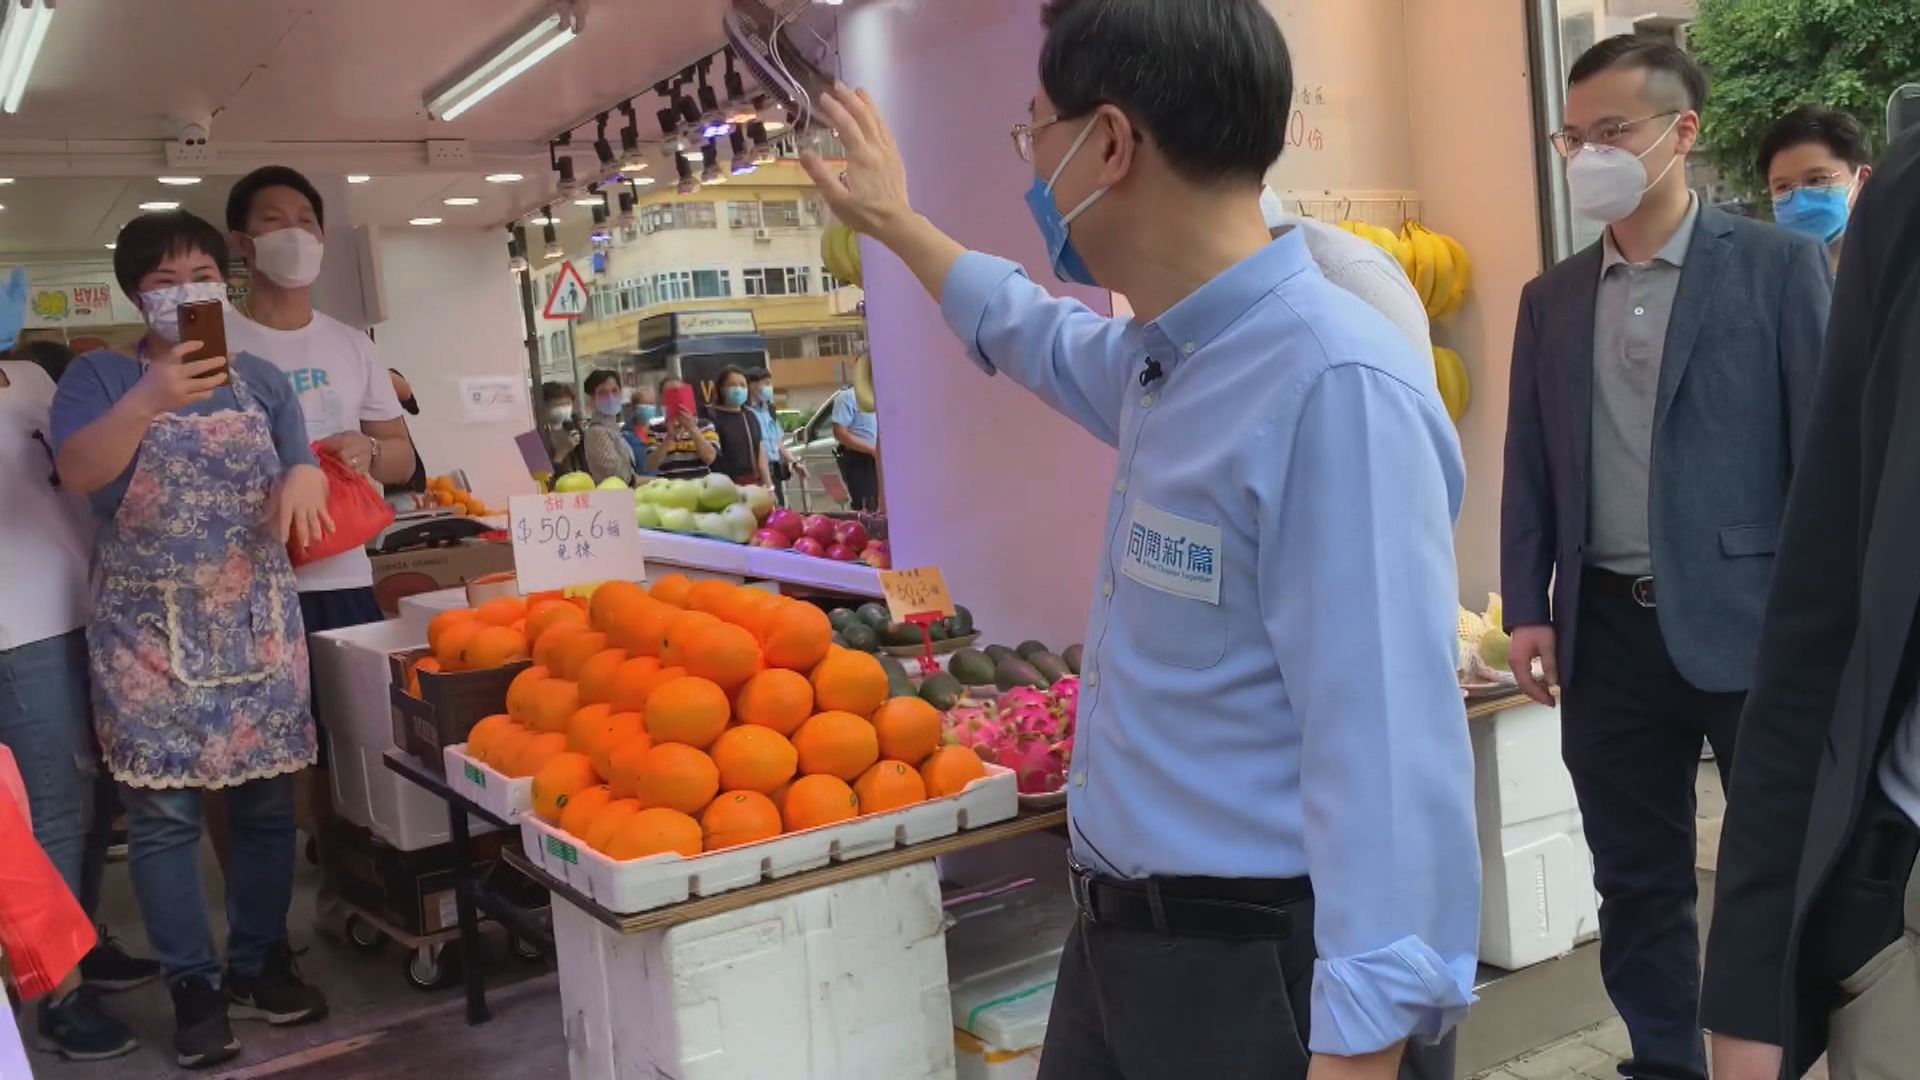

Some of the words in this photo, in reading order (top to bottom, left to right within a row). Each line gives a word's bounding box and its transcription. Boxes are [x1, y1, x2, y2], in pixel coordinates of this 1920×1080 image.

[1283, 110, 1324, 151] 0份
[1127, 522, 1213, 574] 同開新篇
